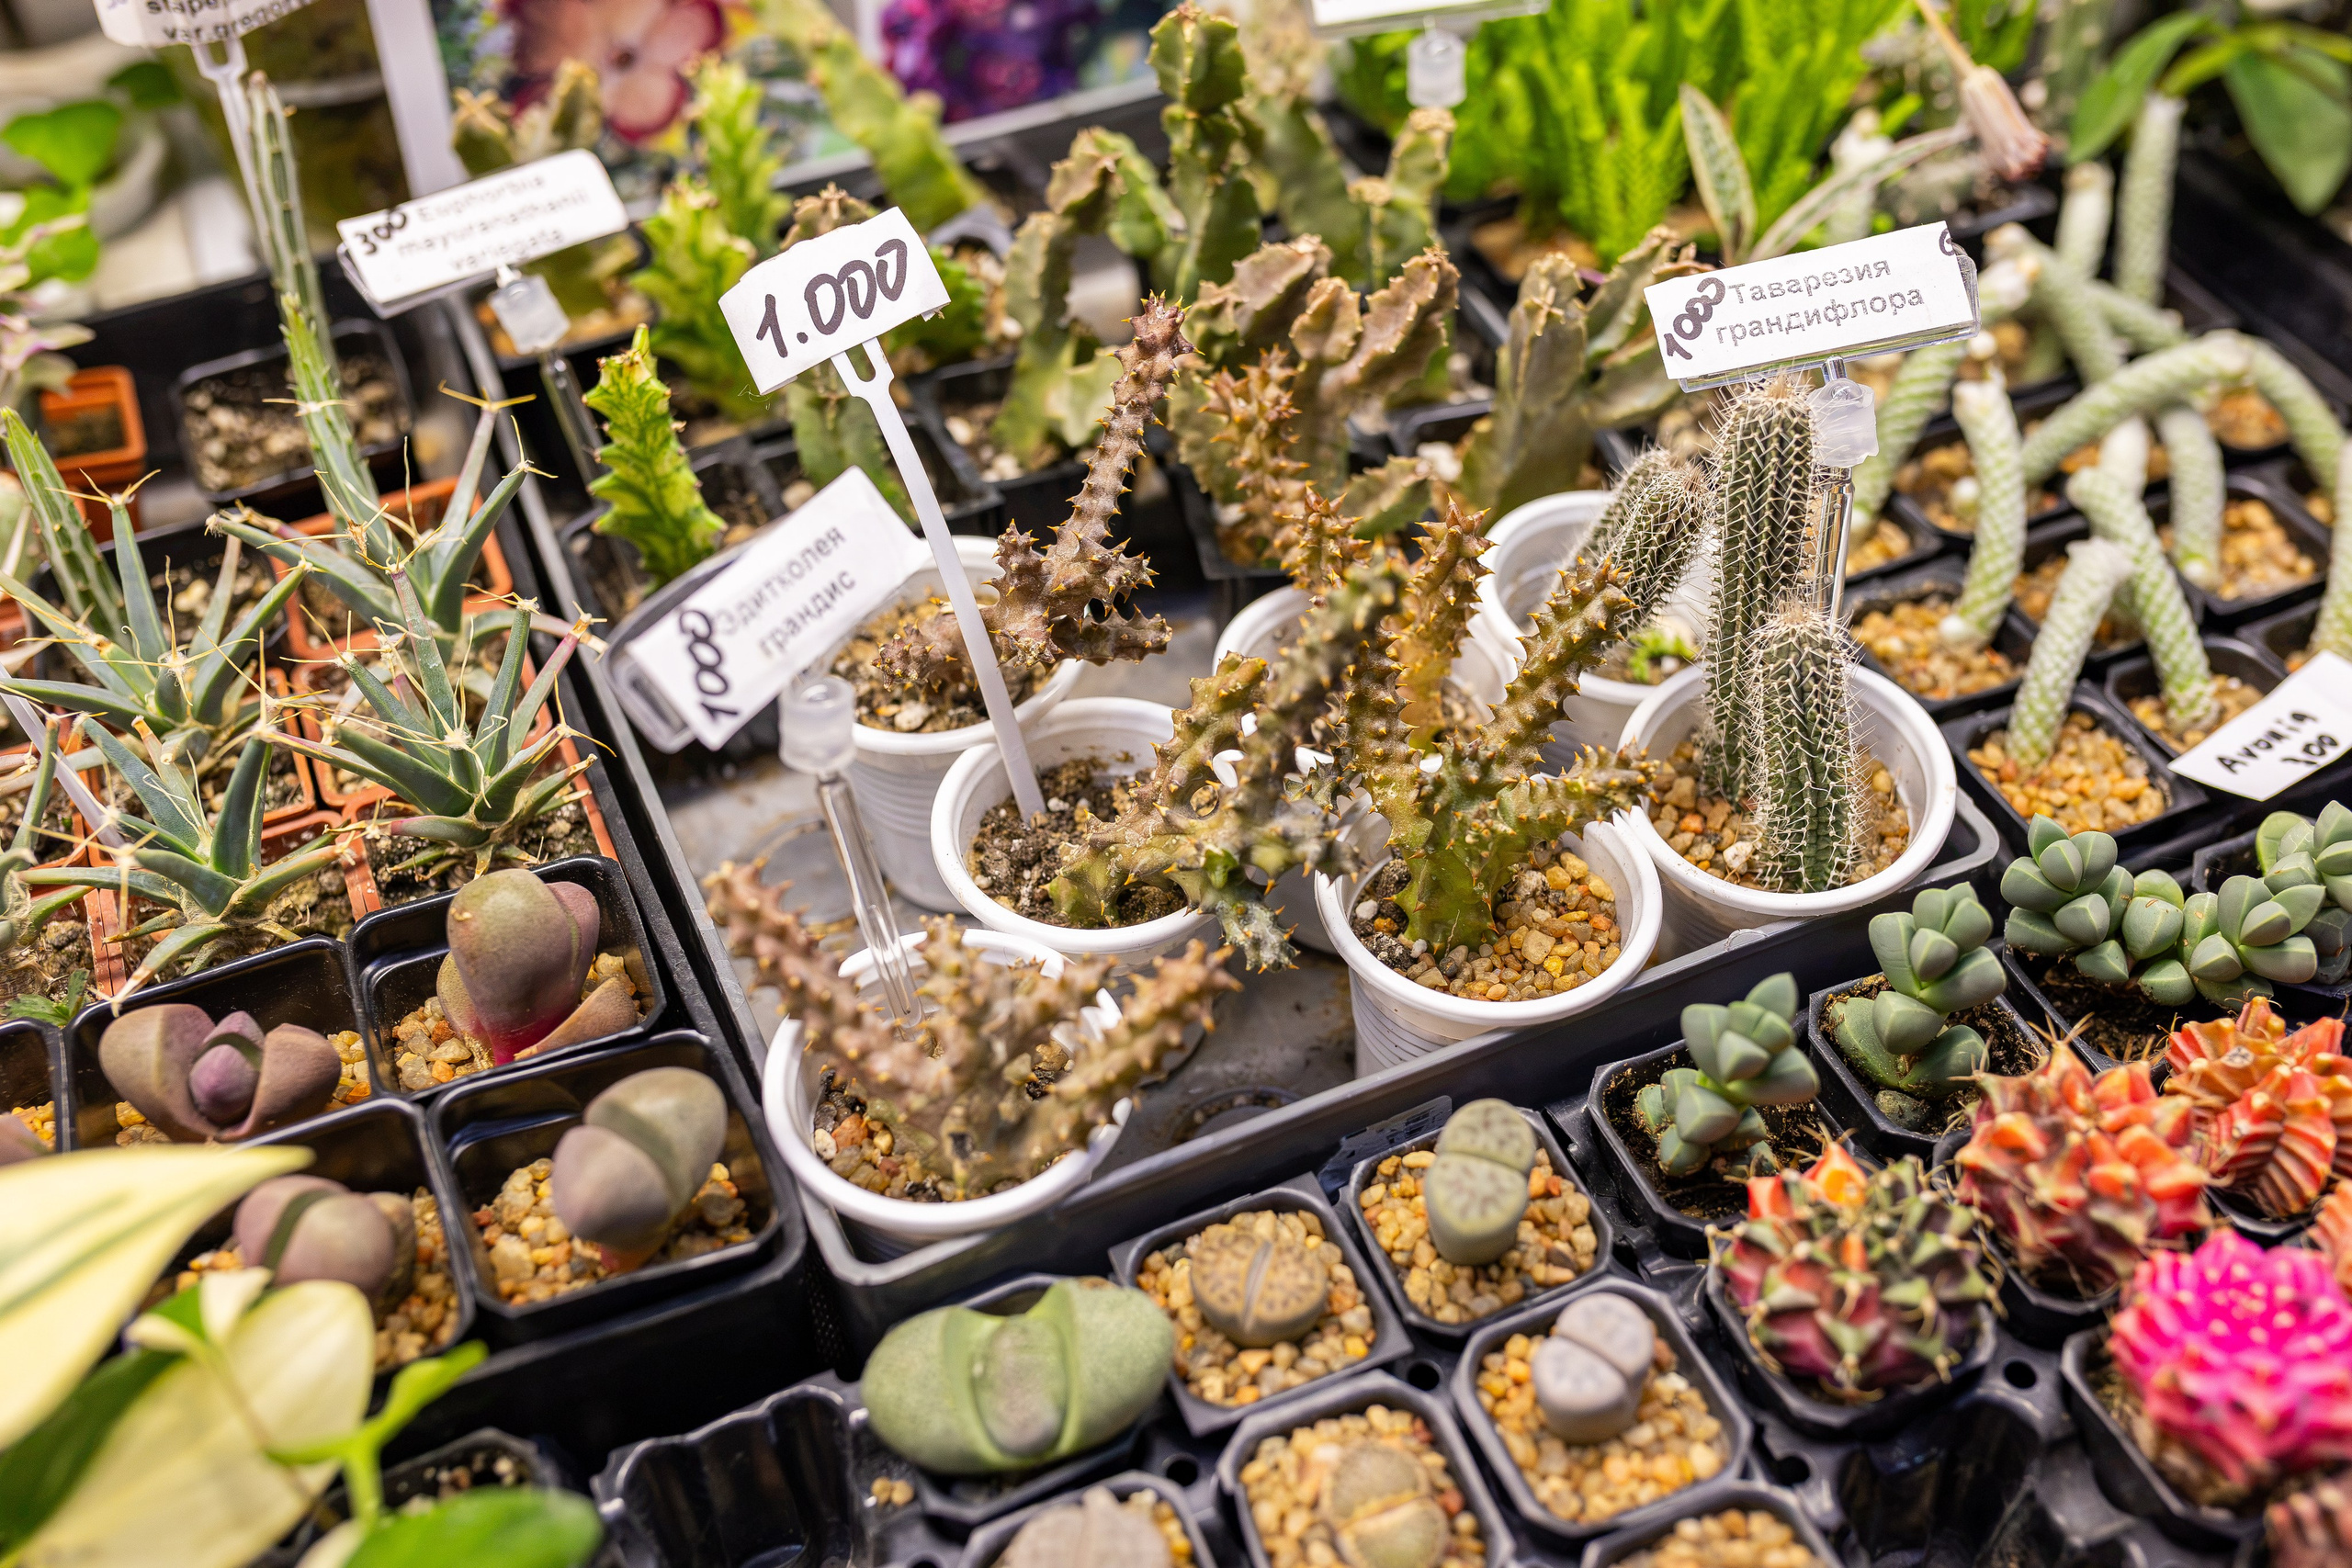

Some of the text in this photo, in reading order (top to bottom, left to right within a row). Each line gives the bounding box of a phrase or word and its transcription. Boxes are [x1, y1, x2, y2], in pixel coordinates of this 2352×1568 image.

[355, 206, 407, 255] 300
[756, 239, 907, 357] 1.000
[1664, 276, 1725, 360] 1000
[1715, 287, 1925, 347] грандифлора
[1728, 259, 1891, 304] Таварезия
[714, 525, 846, 636] Эдитколея
[759, 570, 856, 657] грандис
